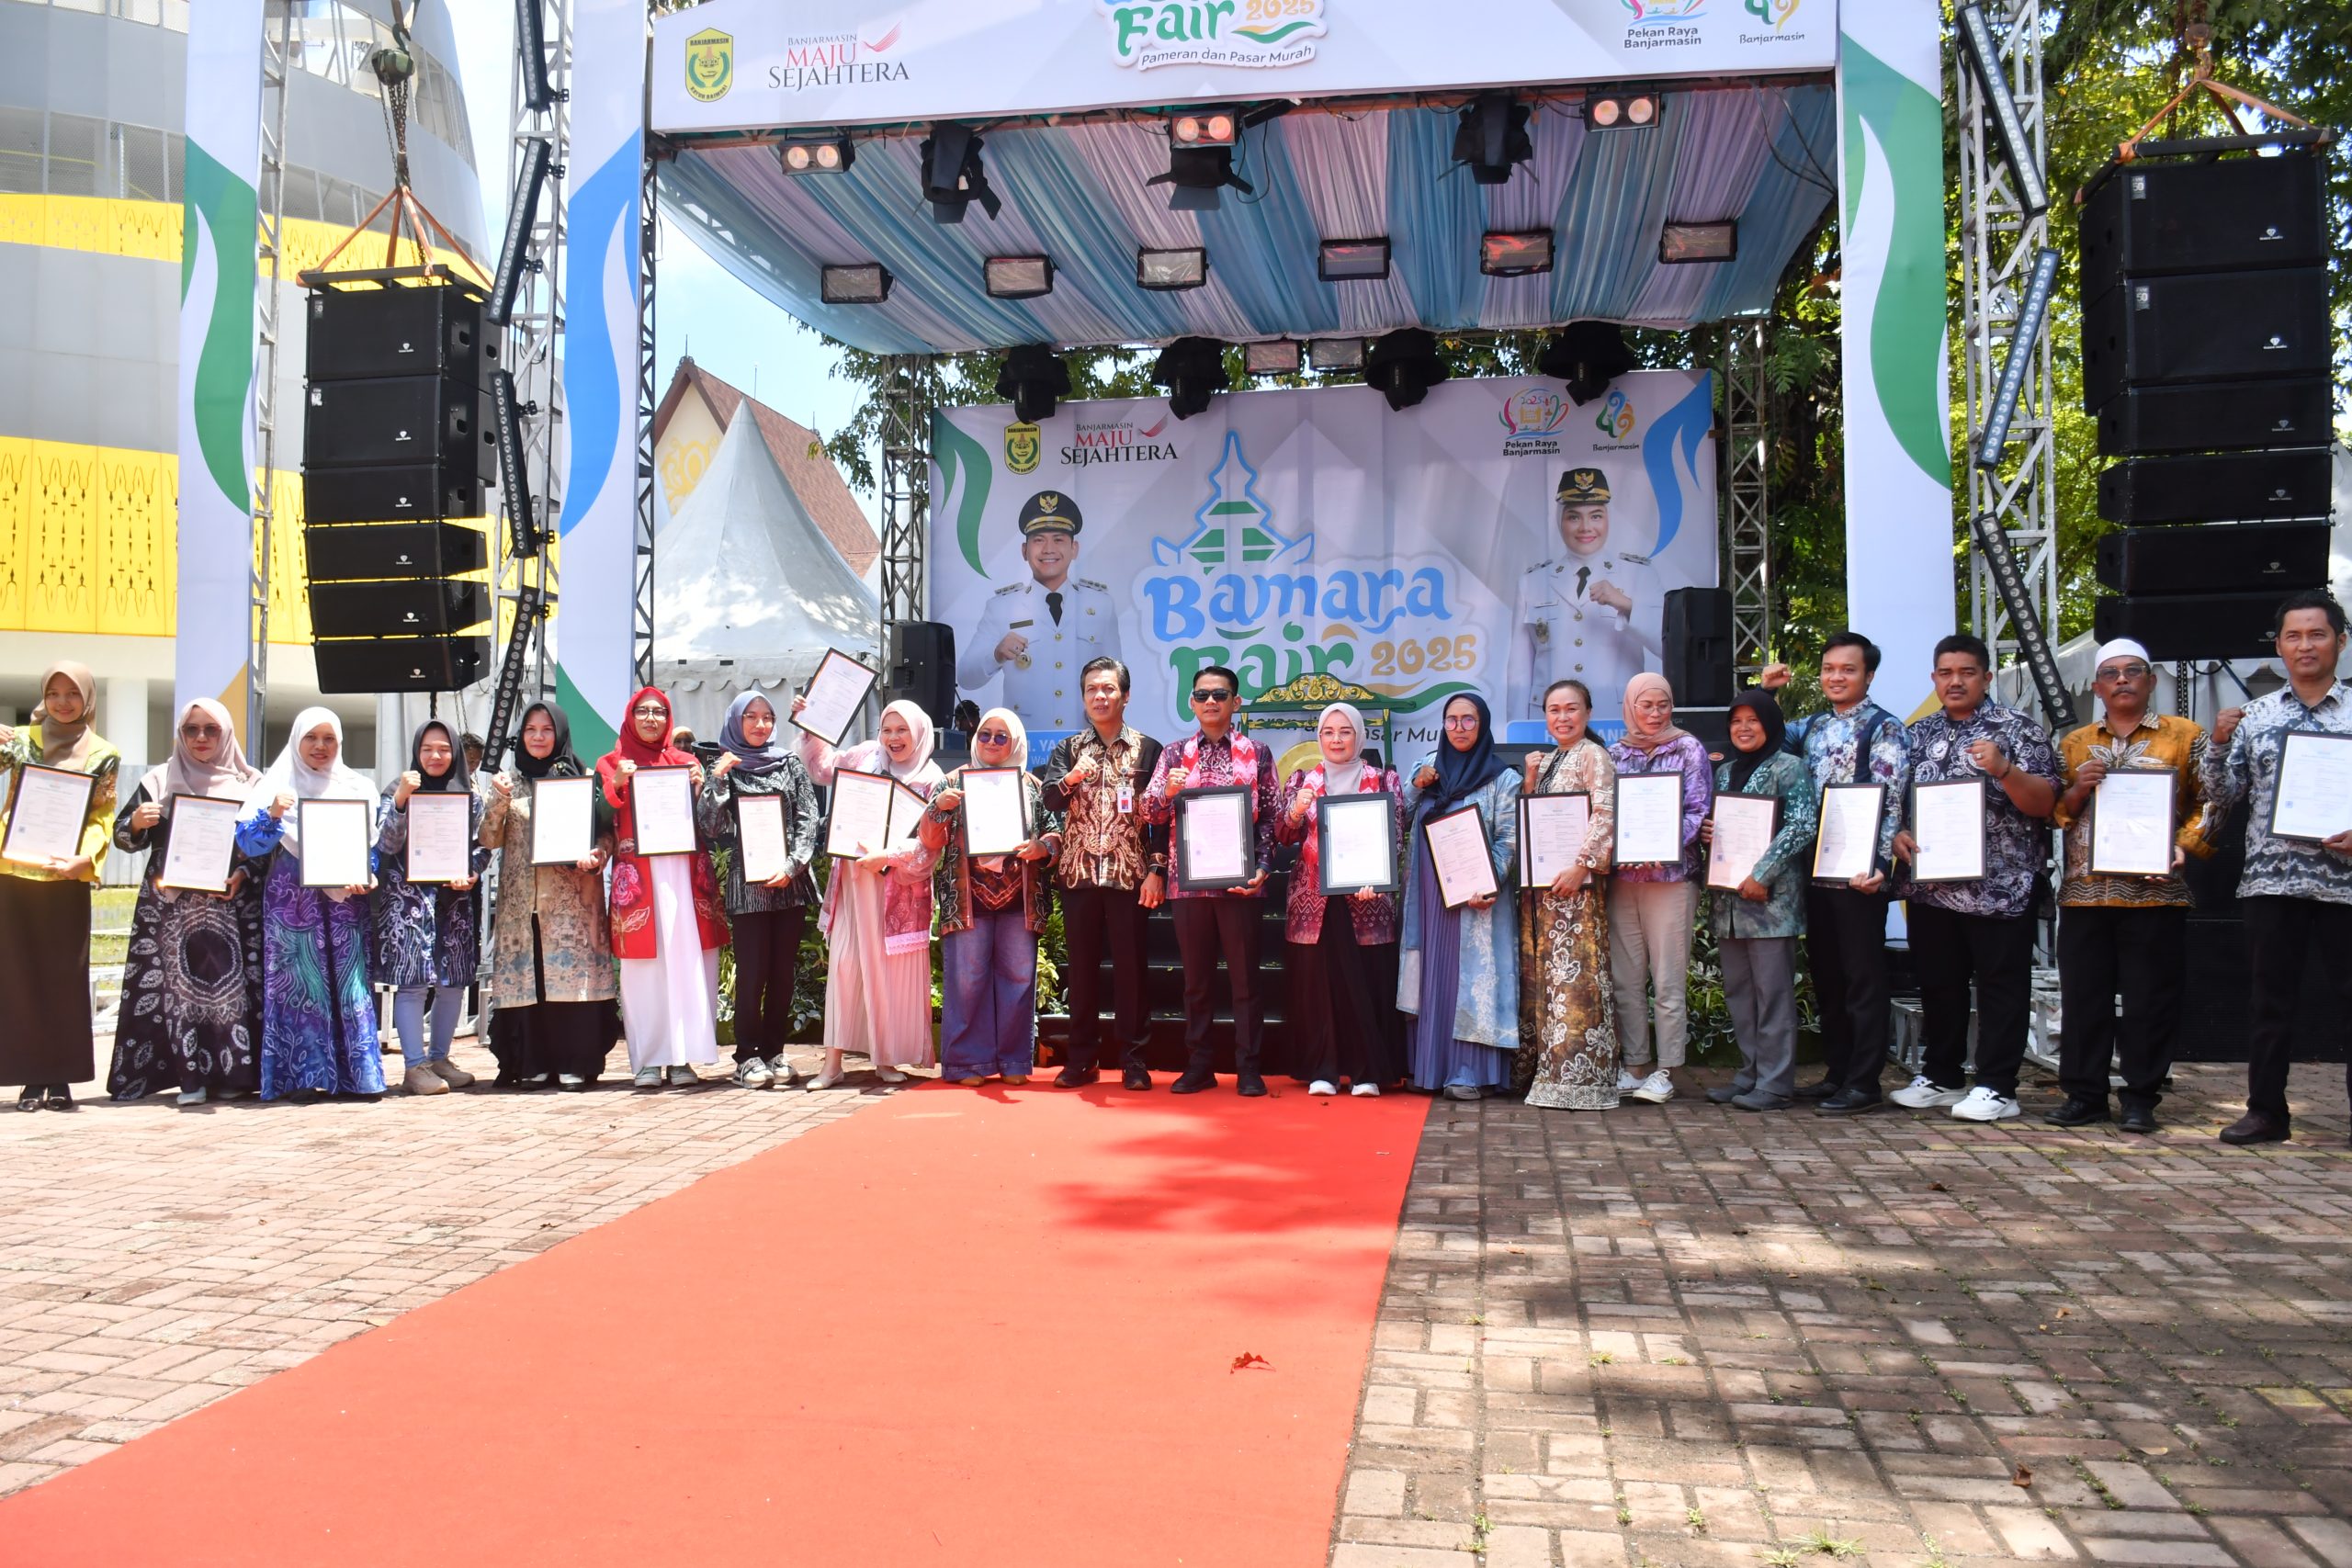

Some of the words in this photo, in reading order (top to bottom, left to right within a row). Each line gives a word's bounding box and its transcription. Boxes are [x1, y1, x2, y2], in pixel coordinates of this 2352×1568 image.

[787, 33, 857, 46] BANJARMASIN
[1627, 28, 1665, 39] Pekan
[1668, 27, 1698, 38] Raya
[1739, 32, 1805, 45] Banjarmasin
[1624, 36, 1702, 50] Banjarmasin
[786, 43, 856, 71] MAJU
[1141, 51, 1198, 66] Pameran
[1202, 47, 1227, 61] dan
[1229, 51, 1266, 62] Pasar
[1269, 46, 1312, 62] Murah
[768, 62, 911, 92] SEJAHTERA
[1076, 423, 1133, 432] BANJARMASIN
[1075, 430, 1133, 449] MAJU
[1535, 440, 1557, 448] Raya
[1503, 447, 1560, 457] Banjarmasin
[1592, 443, 1639, 453] Banjarmasin
[1060, 443, 1178, 468] SEJAHTERA
[1143, 567, 1453, 642] Bamara
[1370, 634, 1477, 676] 2025
